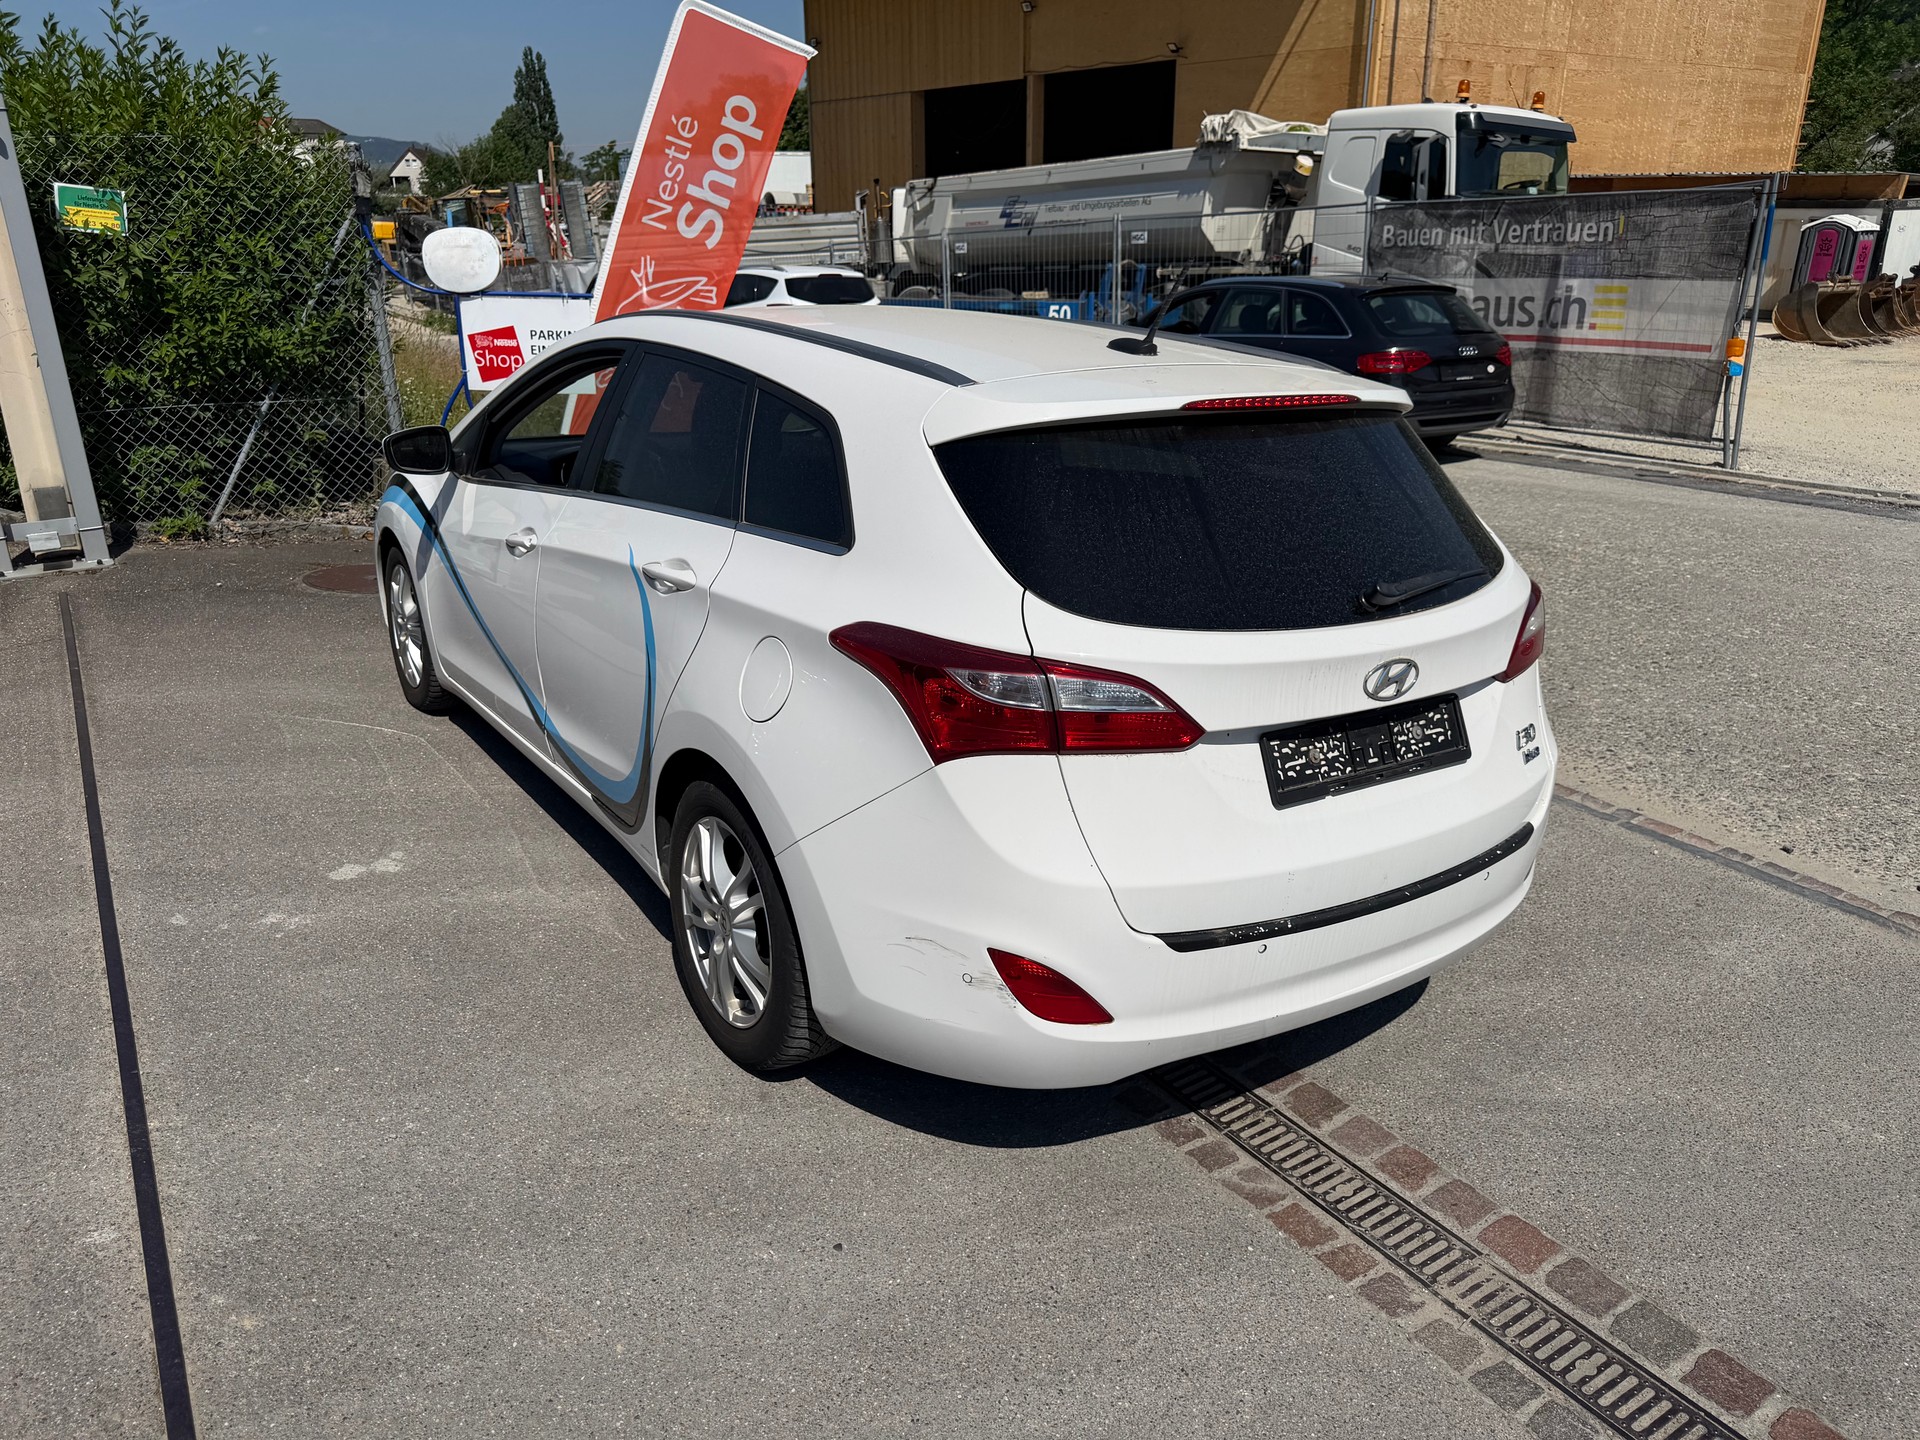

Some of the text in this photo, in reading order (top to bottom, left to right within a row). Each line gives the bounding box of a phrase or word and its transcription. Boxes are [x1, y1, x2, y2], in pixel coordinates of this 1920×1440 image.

[641, 114, 698, 230] Nestlé
[676, 95, 764, 250] Shop
[1382, 213, 1625, 248] Bauen mit Vertrauen!
[1459, 285, 1587, 330] aus.ch
[474, 349, 523, 372] Shop
